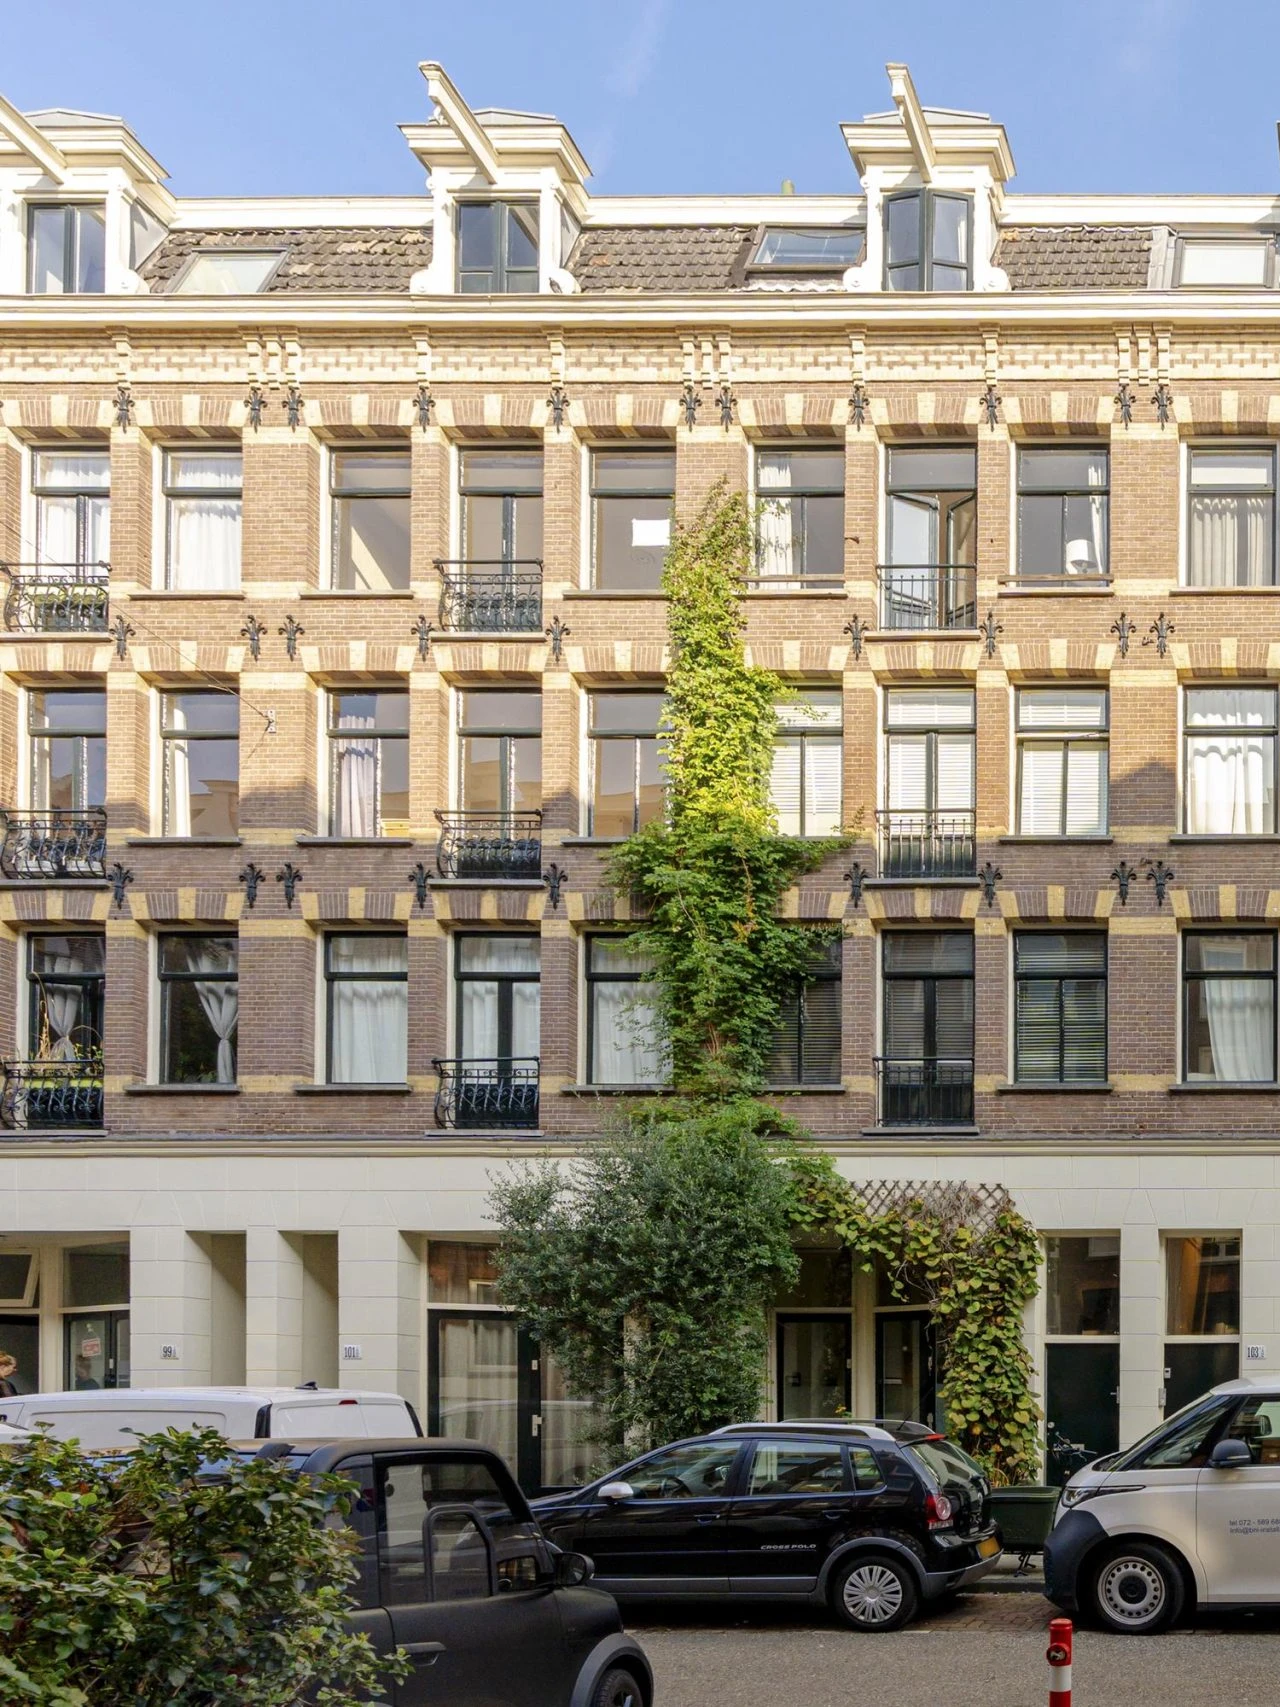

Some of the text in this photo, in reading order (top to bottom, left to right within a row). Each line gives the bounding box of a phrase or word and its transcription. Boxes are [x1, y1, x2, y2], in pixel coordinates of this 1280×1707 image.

[162, 1345, 172, 1358] 99
[344, 1346, 355, 1358] 101
[1247, 1346, 1259, 1358] 103
